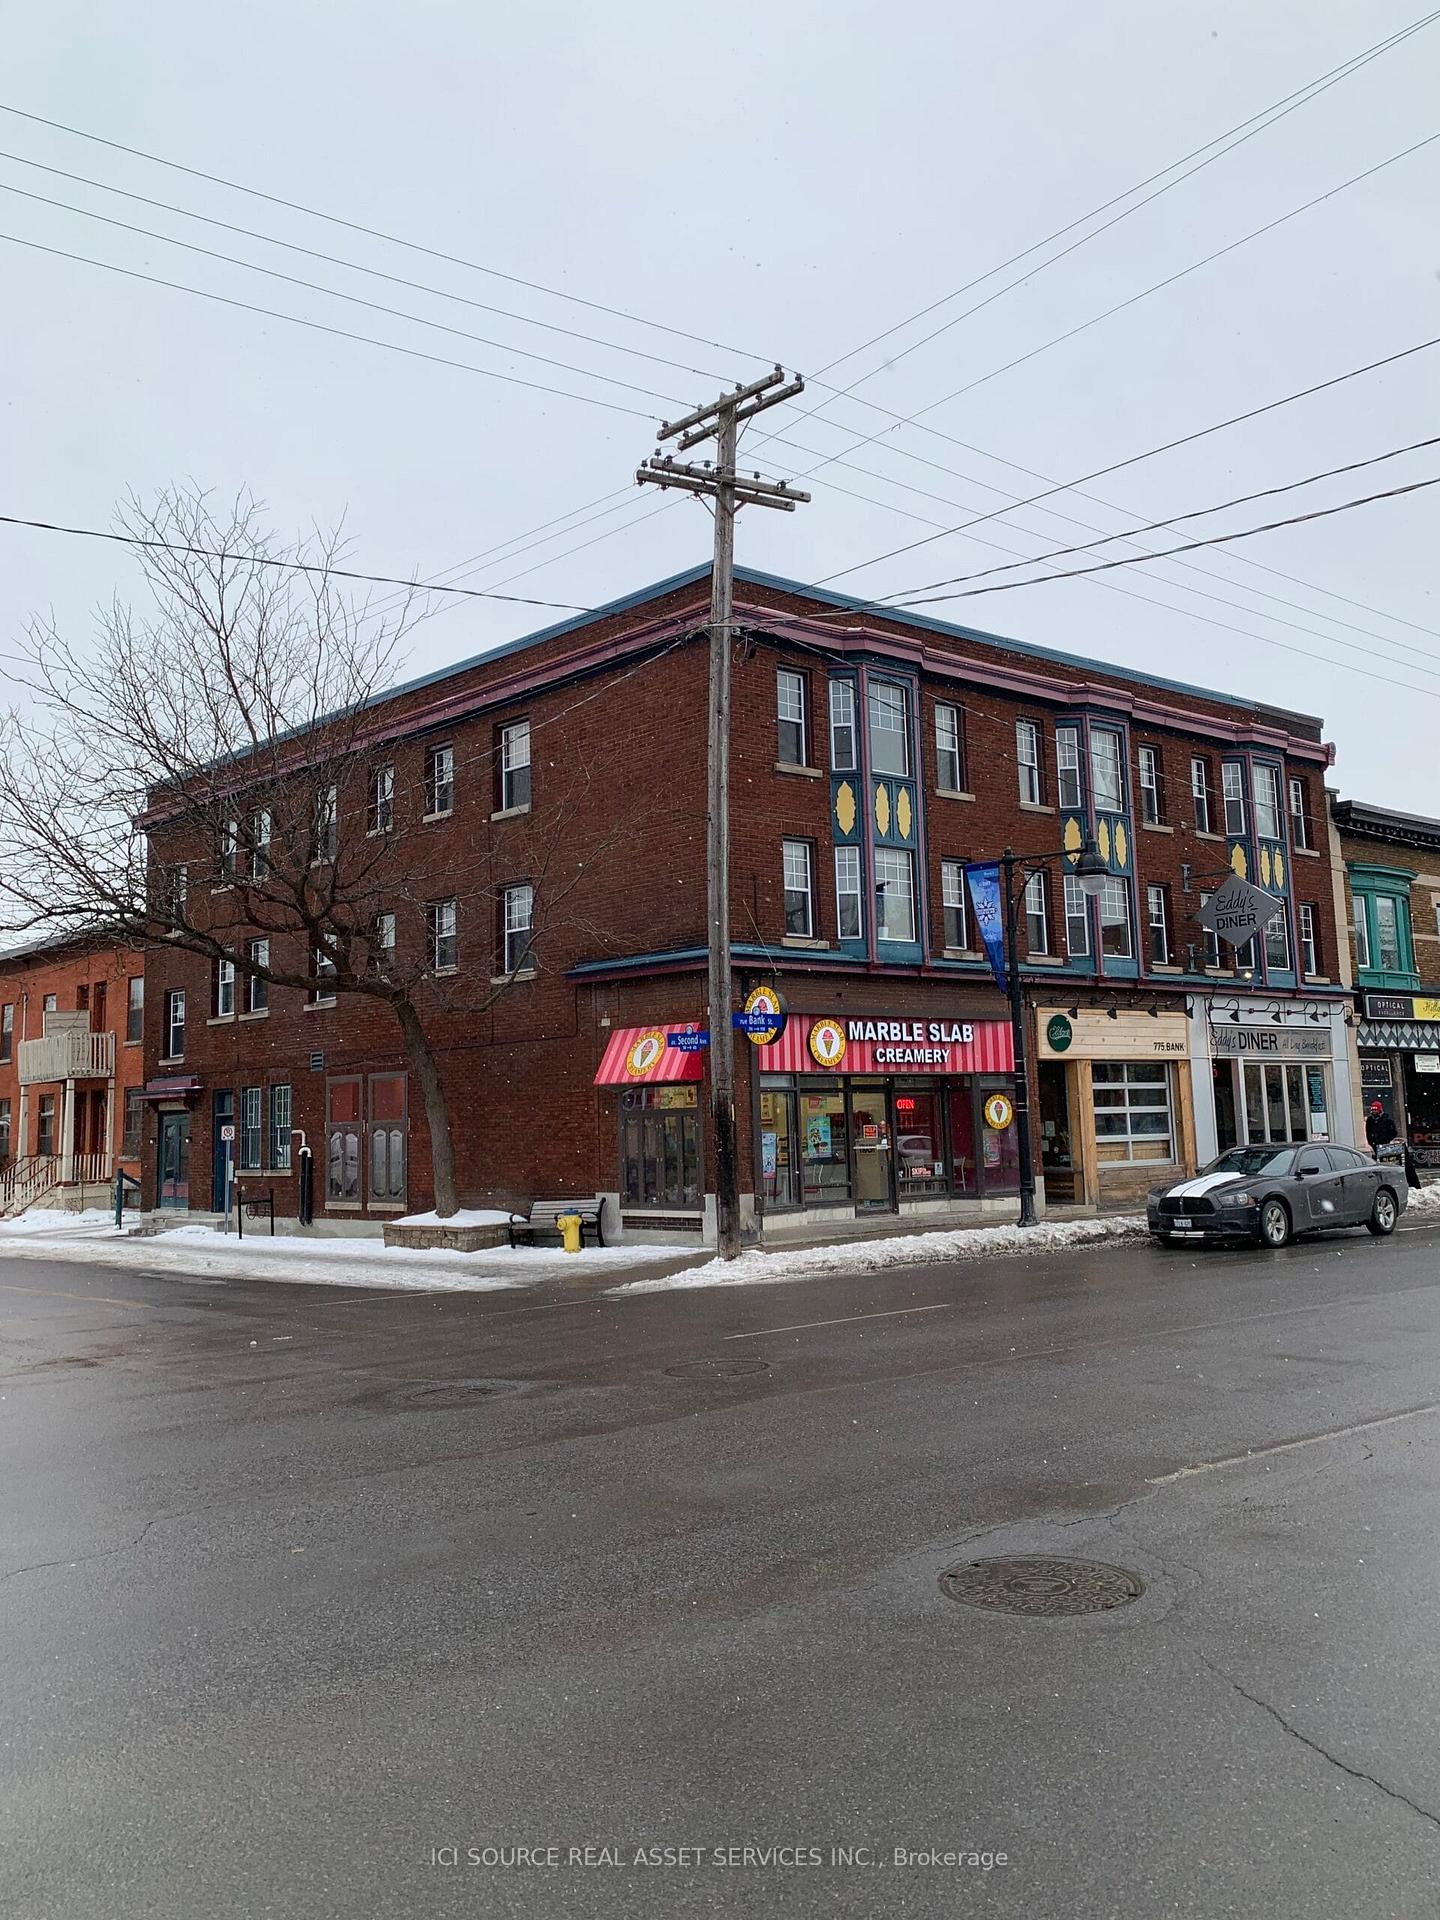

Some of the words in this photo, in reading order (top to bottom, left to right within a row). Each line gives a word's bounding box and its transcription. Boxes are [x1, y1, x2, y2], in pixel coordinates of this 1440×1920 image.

[1215, 888, 1255, 913] Eddy's
[1216, 913, 1257, 930] DINER
[749, 1015, 765, 1025] Bank
[677, 1034, 699, 1045] Second
[849, 1021, 924, 1042] MARBLE
[929, 1023, 974, 1042] SLAB
[1210, 1027, 1236, 1051] Eddy's
[1238, 1032, 1279, 1051] DINER
[1153, 1042, 1165, 1051] 775
[1166, 1043, 1185, 1052] BANK
[813, 1049, 842, 1065] CREAMERY
[876, 1048, 950, 1064] CREAMERY
[1361, 1064, 1389, 1072] OPTICAL
[896, 1099, 915, 1109] OPEN
